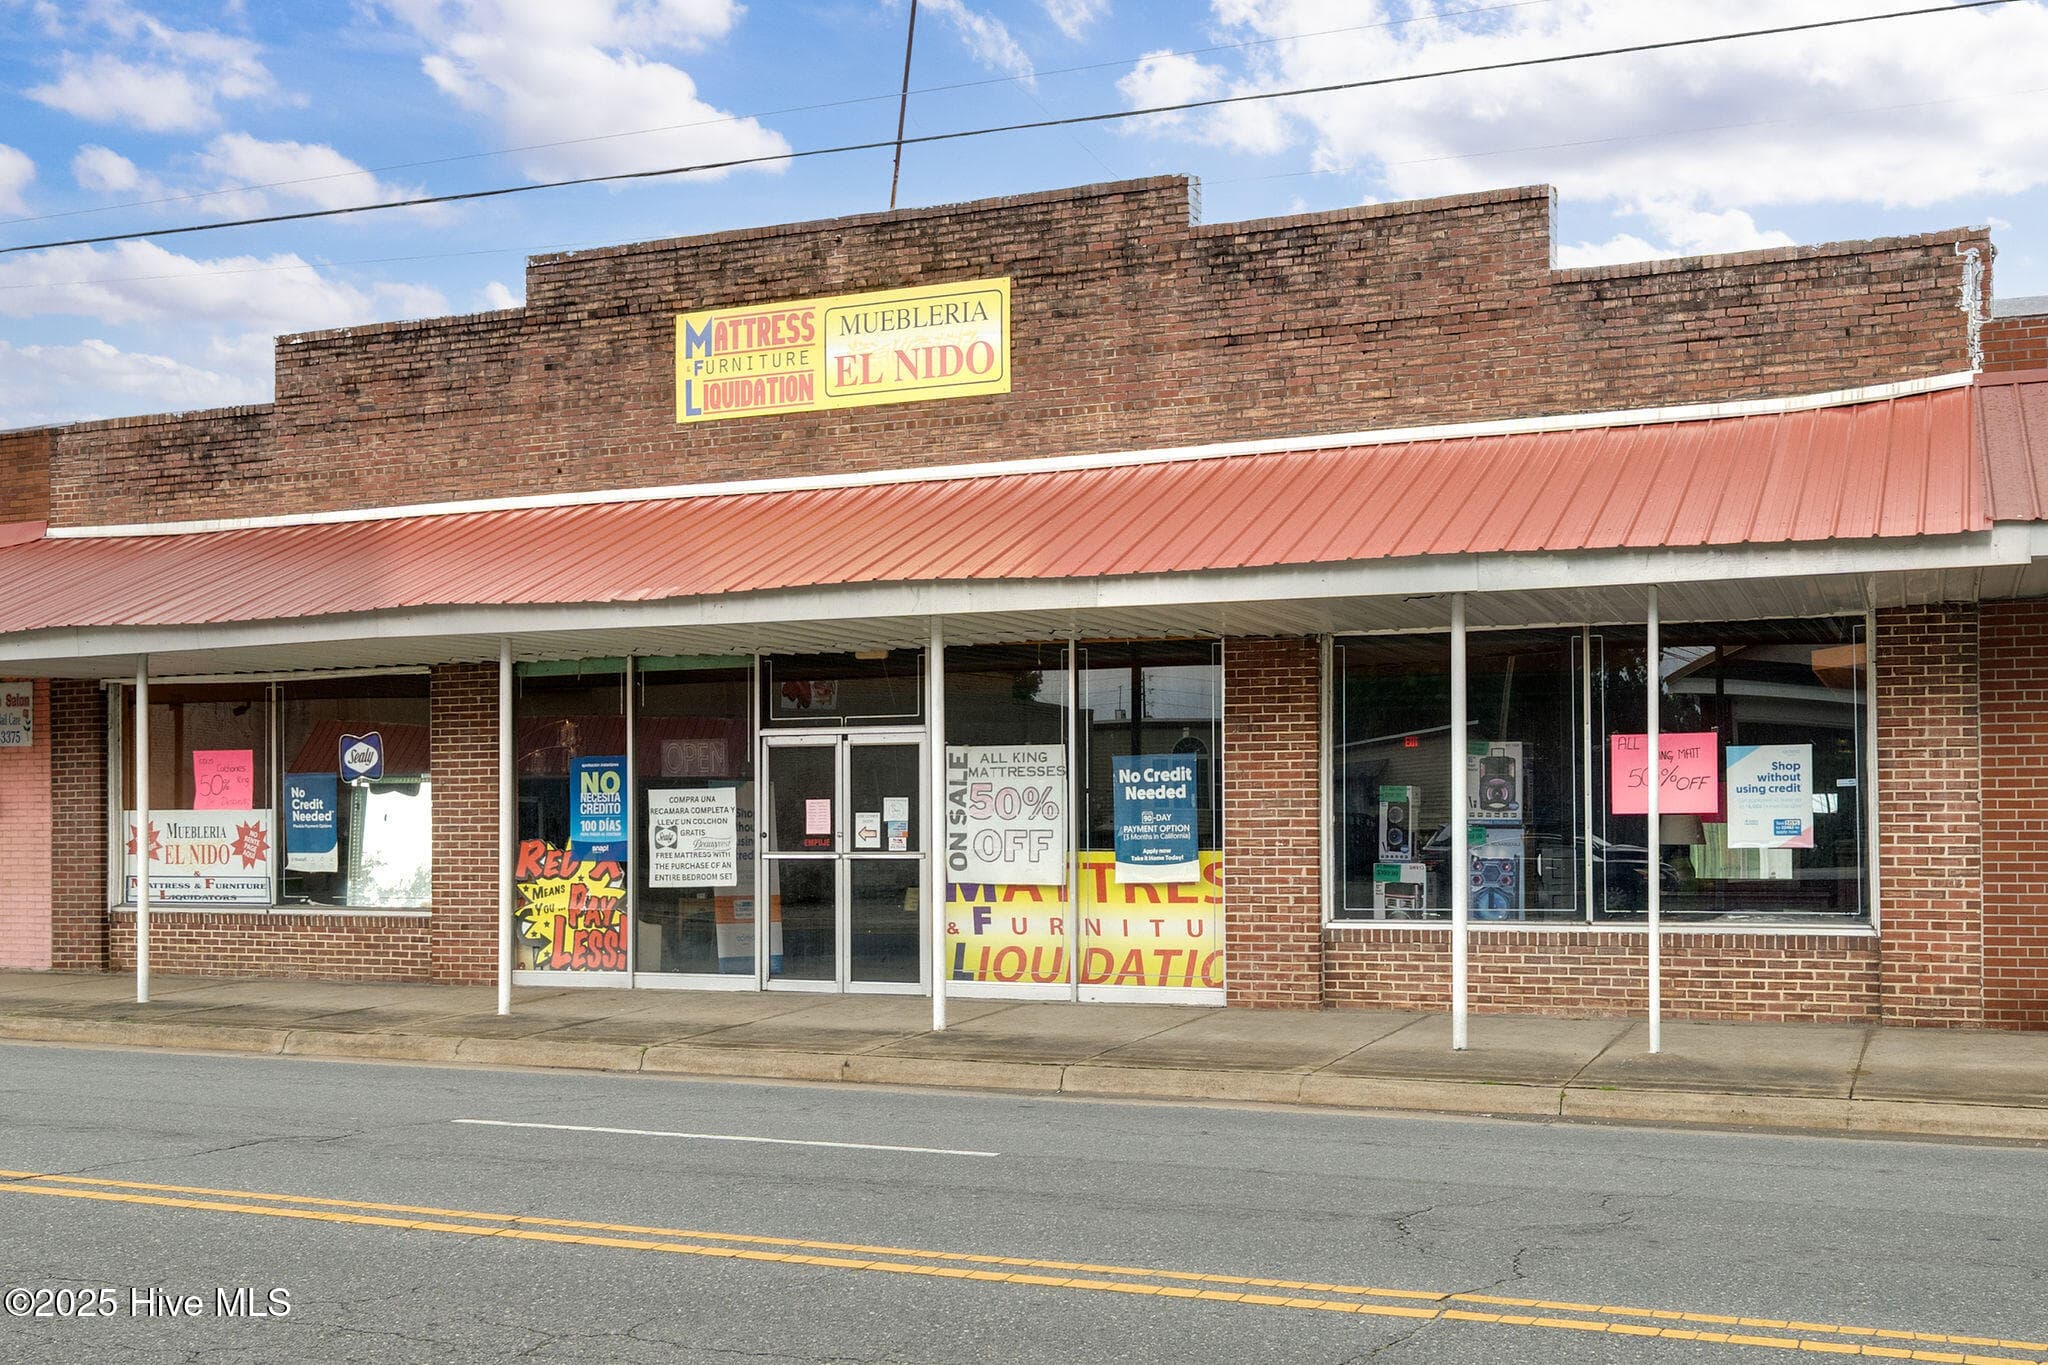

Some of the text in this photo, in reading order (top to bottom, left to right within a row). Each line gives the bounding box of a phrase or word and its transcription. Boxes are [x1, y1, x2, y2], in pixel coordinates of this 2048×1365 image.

[840, 300, 989, 336] MUEBLERIA
[685, 312, 815, 359] MATTRESS
[694, 350, 809, 376] FURNITURE
[834, 341, 995, 388] EL NIDO
[685, 373, 814, 416] LIQUIDATION
[1618, 736, 1639, 750] ALL
[348, 747, 374, 766] Sealy
[664, 742, 726, 773] OPEN
[980, 752, 1048, 763] ALL KING
[1678, 747, 1701, 759] MATT
[968, 765, 1066, 778] MATTRESSES
[1771, 761, 1801, 772] Shop
[1119, 766, 1192, 783] No Credit
[1757, 773, 1801, 782] without
[200, 774, 231, 797] 50%
[580, 771, 621, 795] NO
[1676, 776, 1711, 790] OFF
[1736, 784, 1801, 795] using credit
[291, 787, 305, 798] No
[580, 793, 621, 803] NECESITA
[1125, 784, 1187, 800] Needed
[291, 799, 324, 810] Credit
[969, 782, 1060, 820] 50%
[650, 807, 689, 815] RECAMARA
[948, 753, 968, 871] ON SALE
[166, 823, 227, 839] MUEBLERIA
[580, 818, 622, 832] 100 DÍAS
[1123, 824, 1190, 833] PAYMENT OPTION
[680, 829, 706, 837] GRATIS
[973, 828, 1054, 862] OFF
[164, 844, 184, 865] EL
[190, 843, 230, 865] NIDO
[671, 862, 709, 870] PURCHASE
[204, 878, 267, 890] FURNITURE
[159, 890, 237, 900] LIQUIDATORS
[532, 884, 566, 900] MEANS
[535, 903, 555, 915] YOU
[567, 883, 617, 928] PAY
[946, 921, 960, 935] &
[550, 914, 627, 971] LESS!
